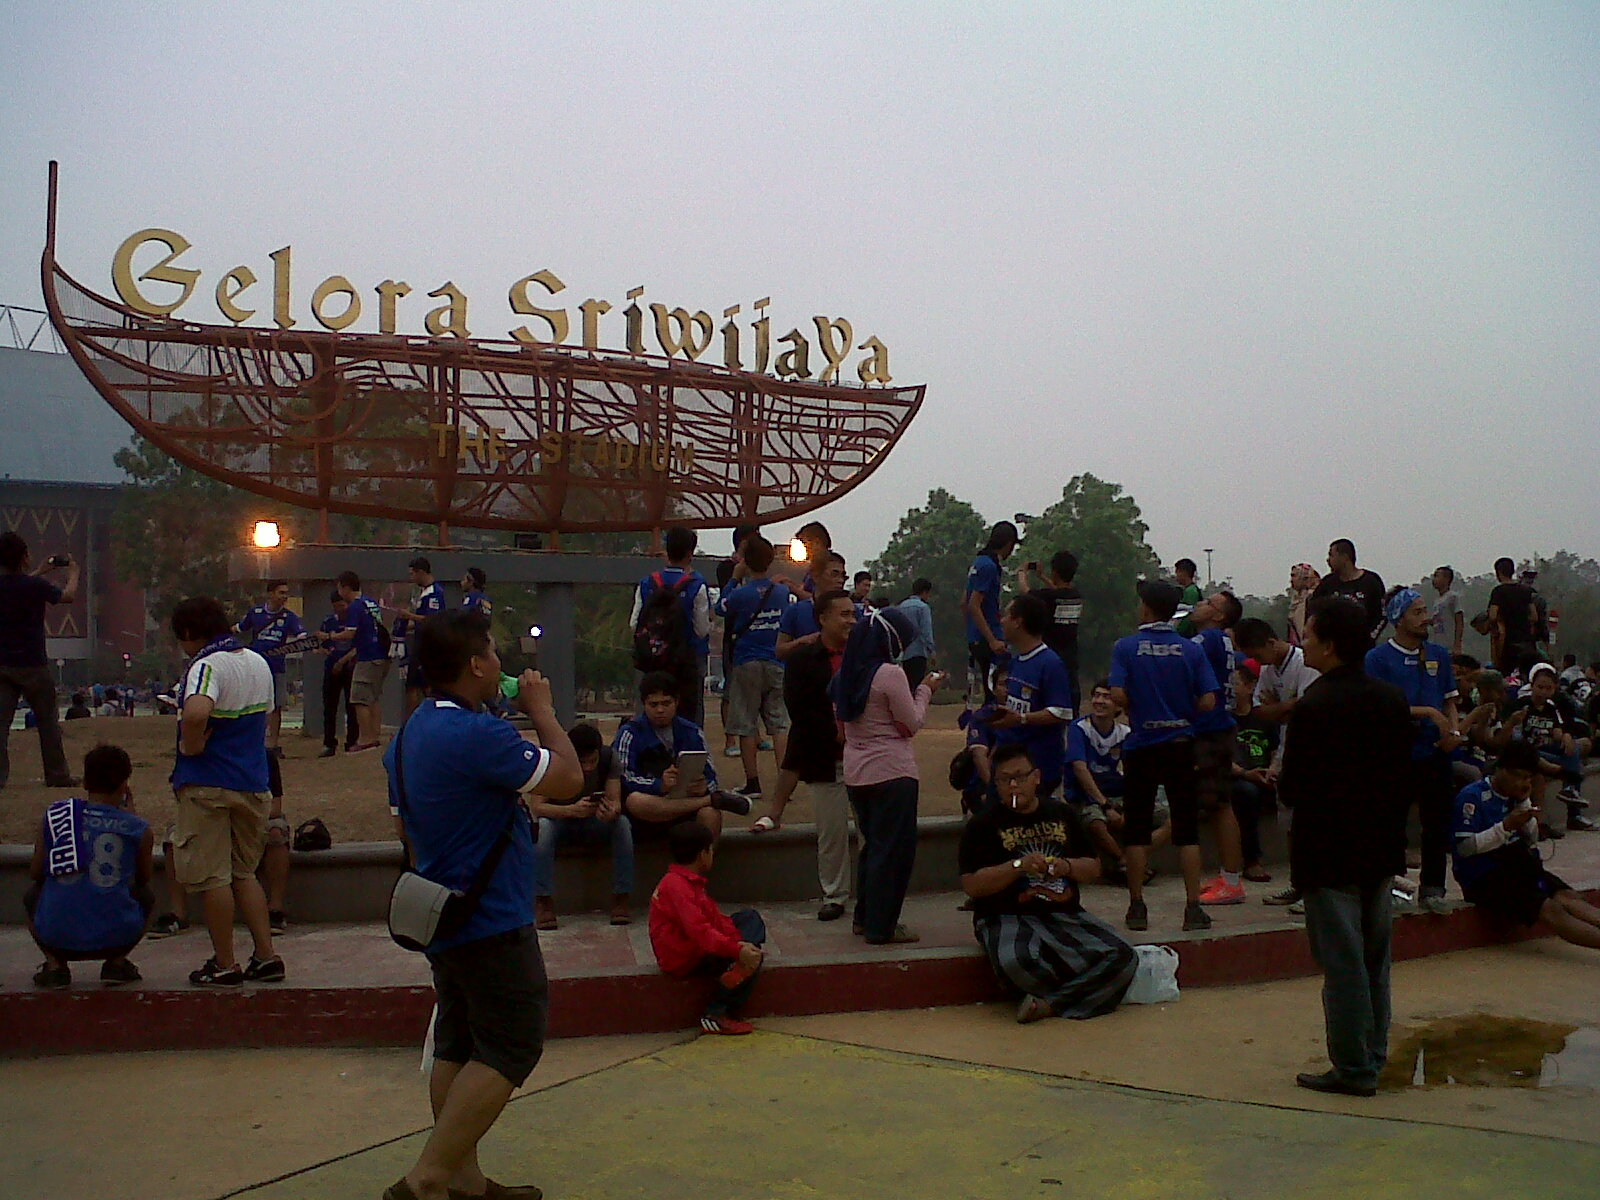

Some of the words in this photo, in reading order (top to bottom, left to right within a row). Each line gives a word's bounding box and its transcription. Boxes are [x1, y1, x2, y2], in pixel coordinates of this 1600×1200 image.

[112, 228, 472, 339] Gelora
[508, 269, 892, 383] Sriwijaya
[430, 422, 508, 463] THE
[539, 431, 695, 476] STADIUM
